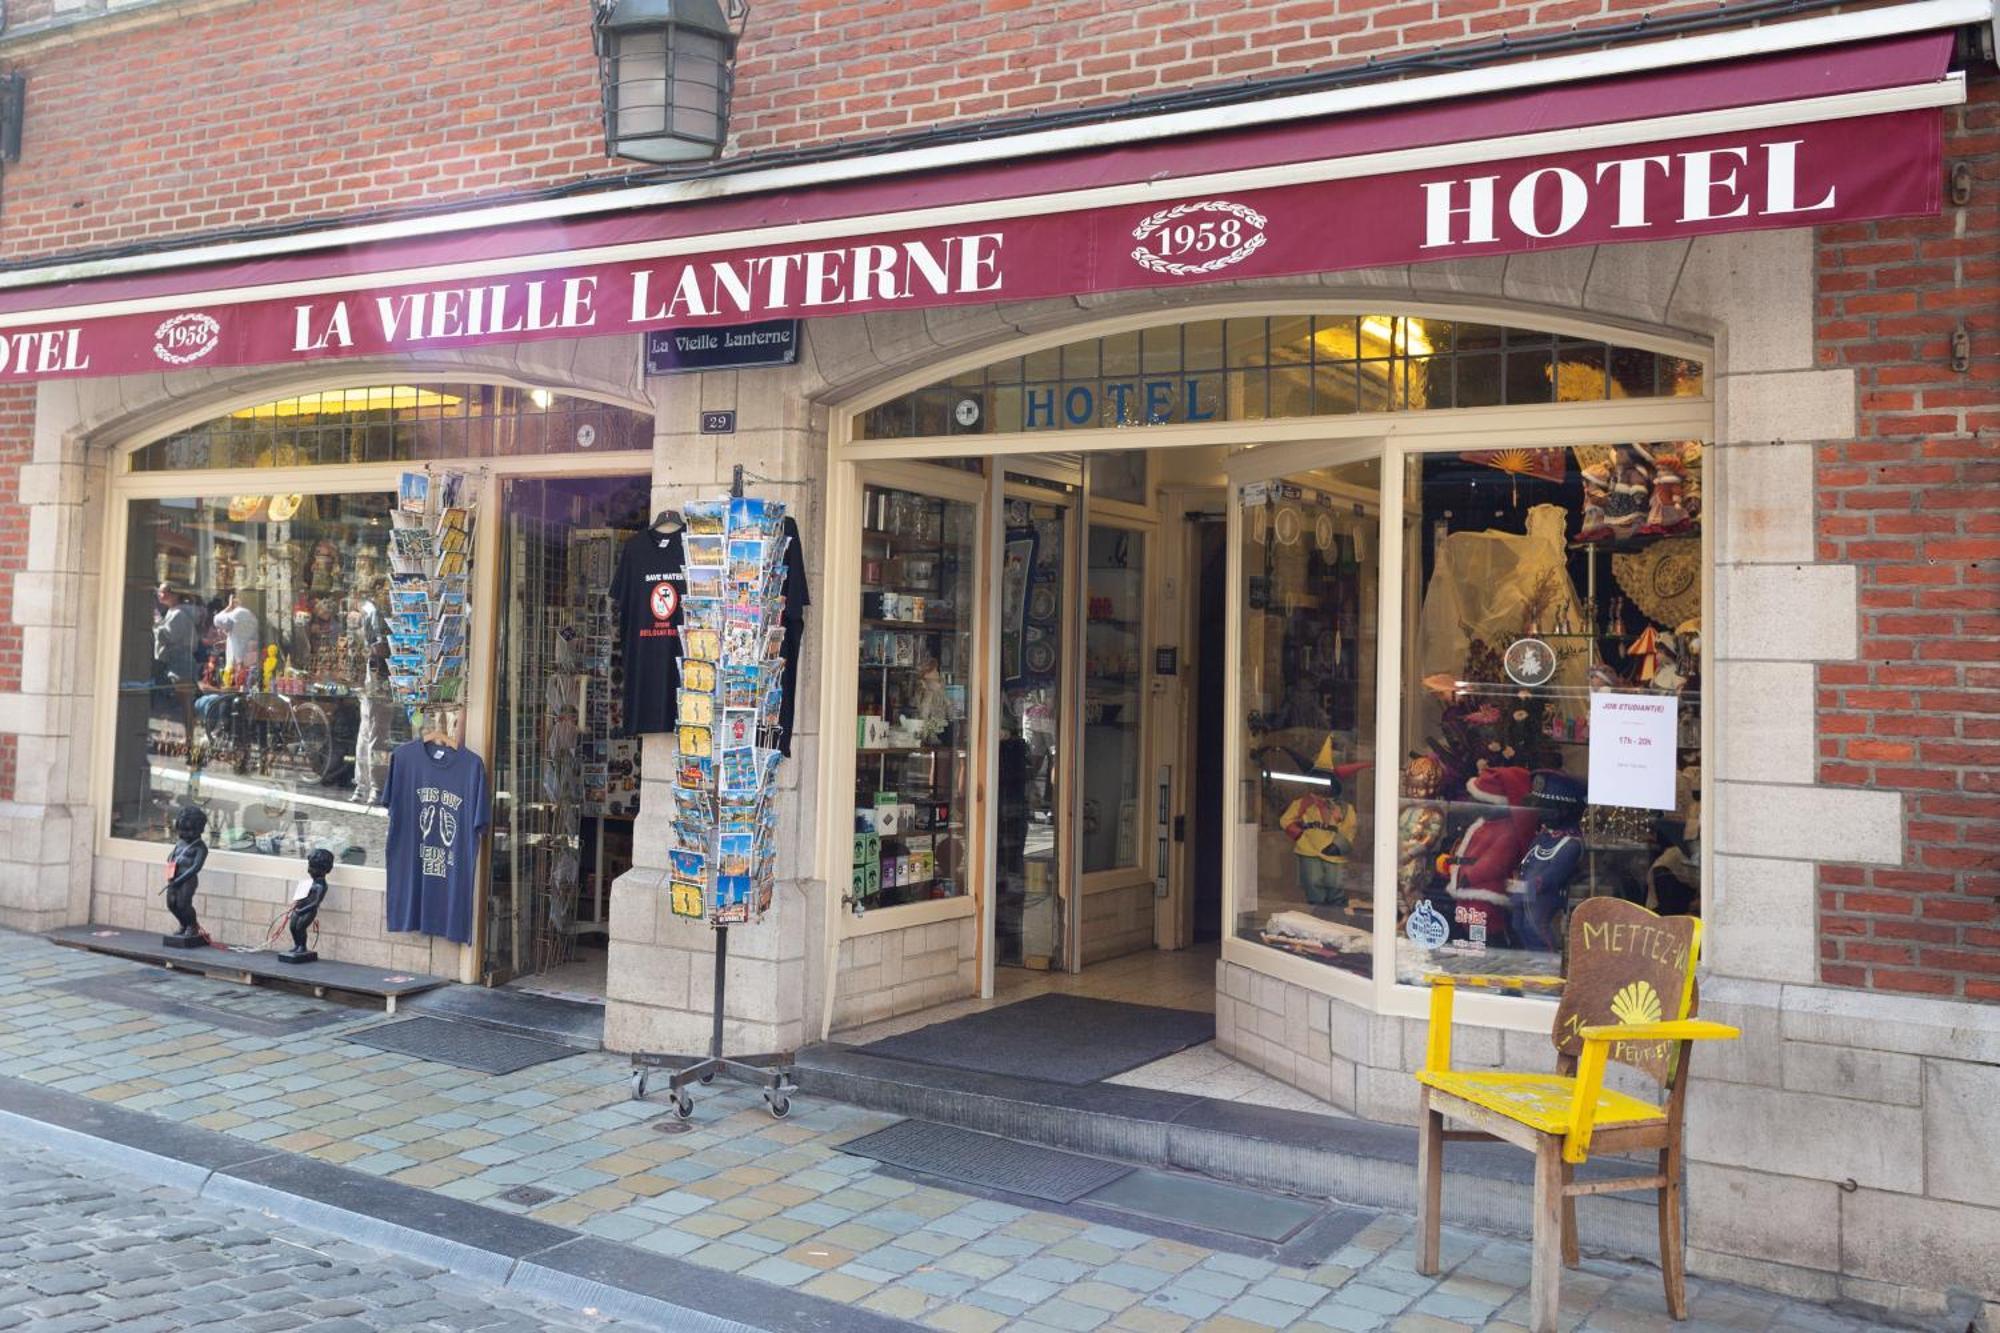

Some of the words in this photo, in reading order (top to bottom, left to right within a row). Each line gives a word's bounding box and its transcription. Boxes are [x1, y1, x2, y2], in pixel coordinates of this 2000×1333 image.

[1418, 139, 1836, 249] HOTEL
[1154, 217, 1243, 257] 1958
[293, 301, 355, 353] LA
[375, 275, 598, 343] VIEILLE
[627, 232, 1004, 323] LANTERNE
[166, 323, 209, 349] 1958
[651, 339, 669, 354] La
[675, 334, 718, 351] Vieille
[724, 330, 791, 348] Lanterne
[1026, 380, 1217, 428] HOTEL
[709, 415, 727, 429] 29
[645, 573, 661, 582] SAVE
